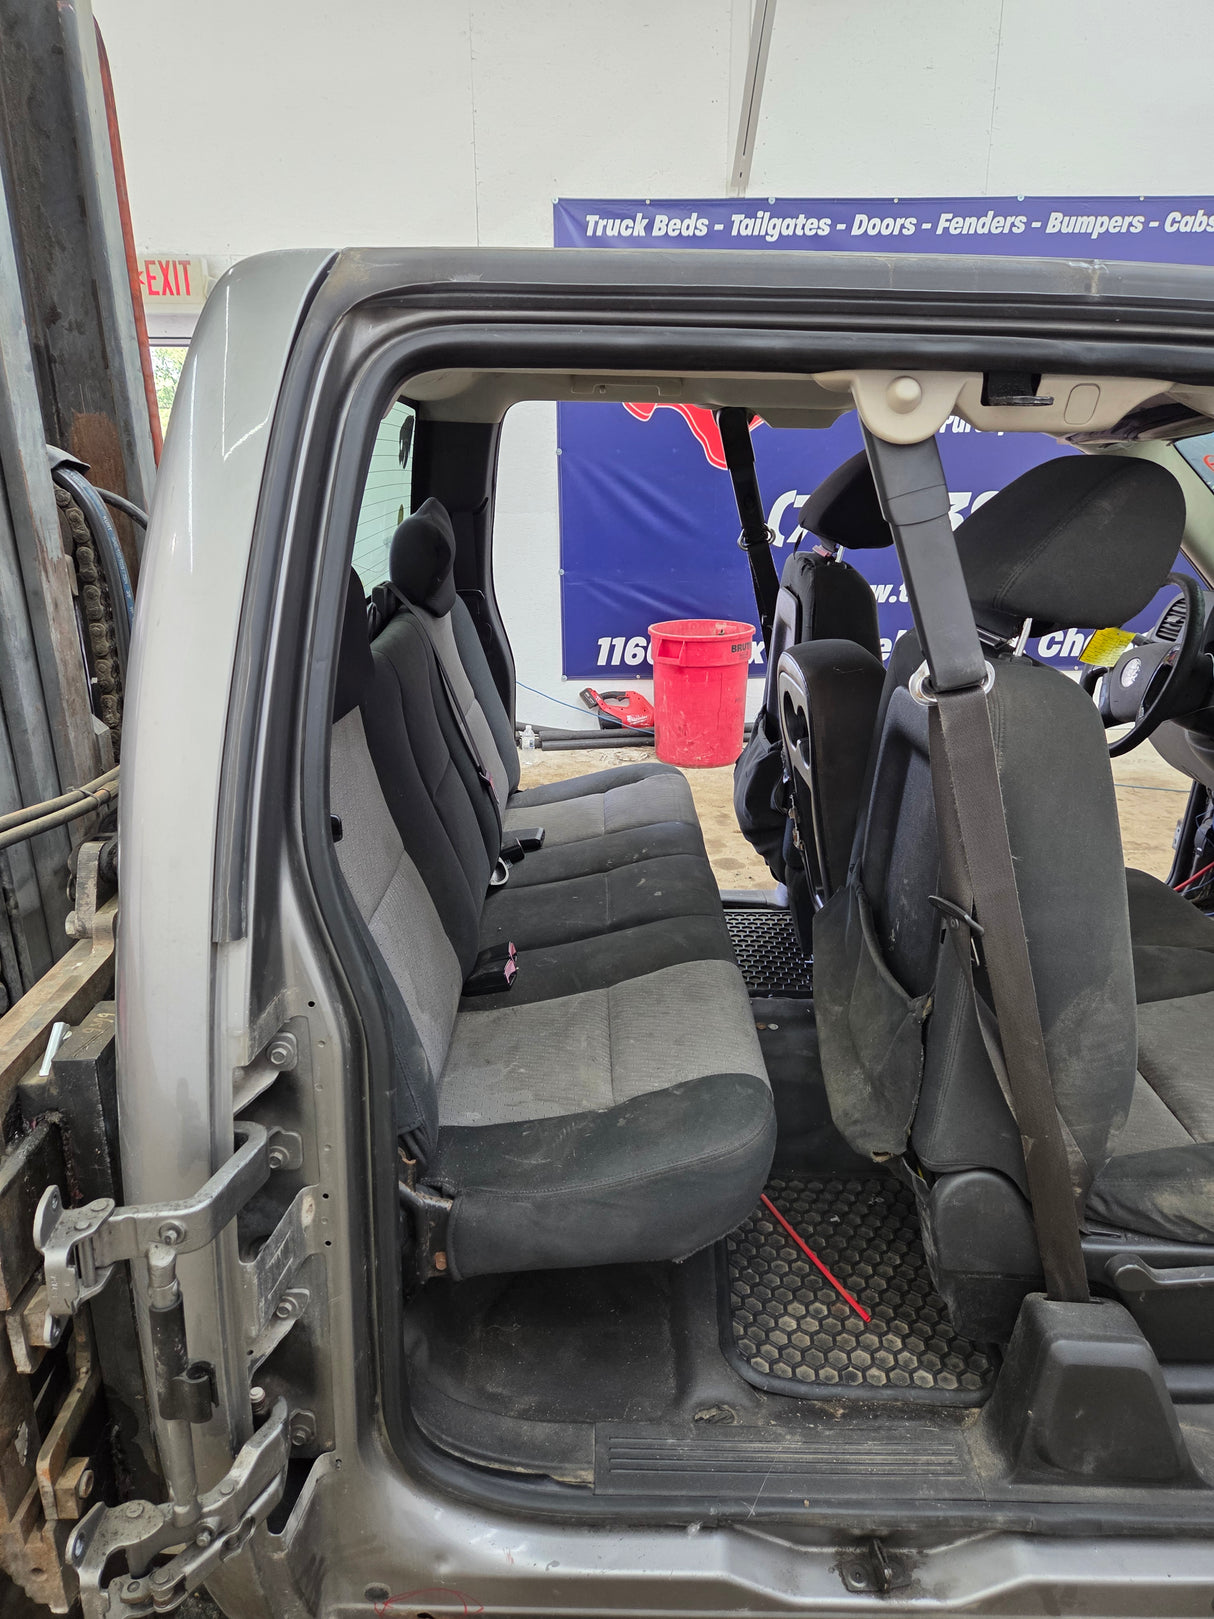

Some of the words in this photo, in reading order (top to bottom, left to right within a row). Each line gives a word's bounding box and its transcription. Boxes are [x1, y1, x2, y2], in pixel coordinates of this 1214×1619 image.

[585, 212, 649, 237] Truck
[651, 212, 709, 237] Beds
[731, 210, 832, 242] Tailgates
[850, 213, 917, 236] Doors
[935, 210, 1027, 235] Fenders
[1045, 212, 1145, 239] Bumpers
[144, 259, 191, 296] EXIT
[597, 636, 654, 666] 116
